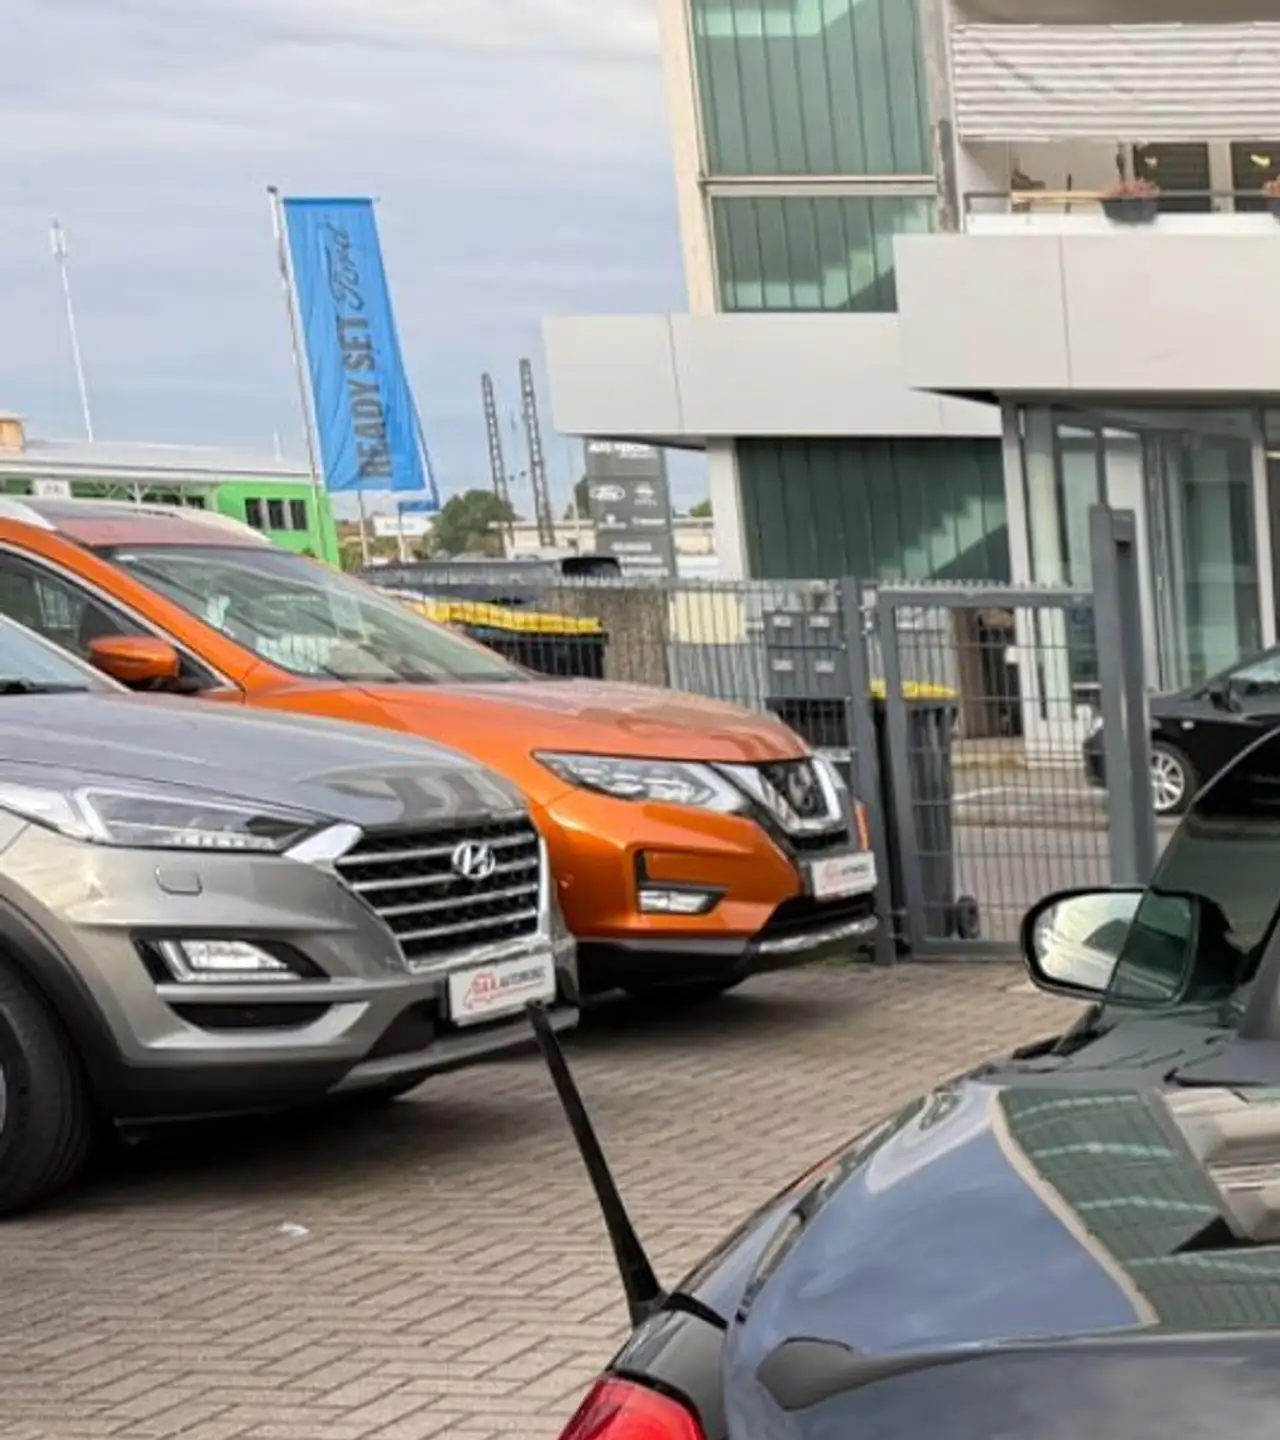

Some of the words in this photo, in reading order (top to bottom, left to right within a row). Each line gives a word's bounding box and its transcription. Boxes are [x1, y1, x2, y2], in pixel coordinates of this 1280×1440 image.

[318, 214, 366, 313] Ford
[336, 313, 377, 374] SET
[347, 377, 394, 480] READY
